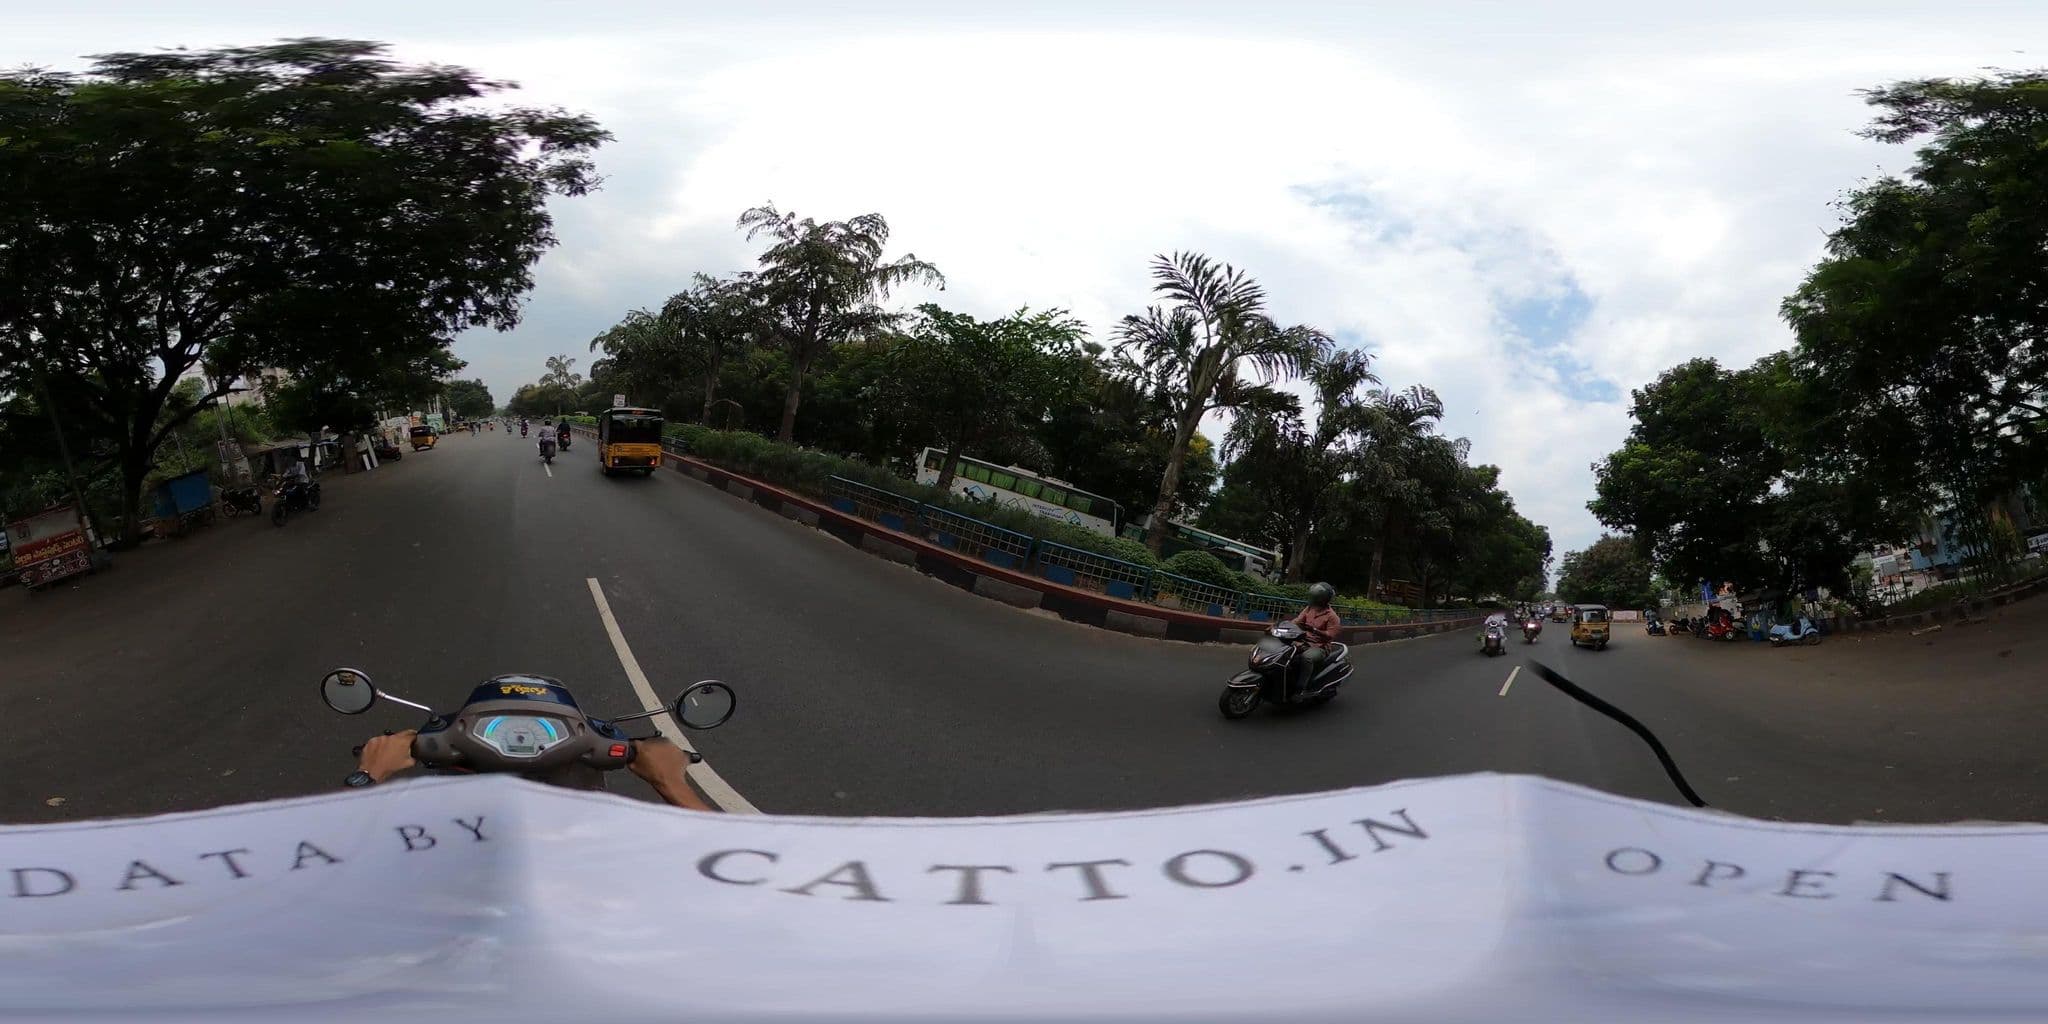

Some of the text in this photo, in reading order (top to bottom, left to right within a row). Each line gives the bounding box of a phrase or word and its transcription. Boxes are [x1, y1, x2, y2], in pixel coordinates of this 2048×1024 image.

[8, 807, 1429, 906] DATA BY CATTO.IN
[1604, 846, 1953, 902] OPEN
